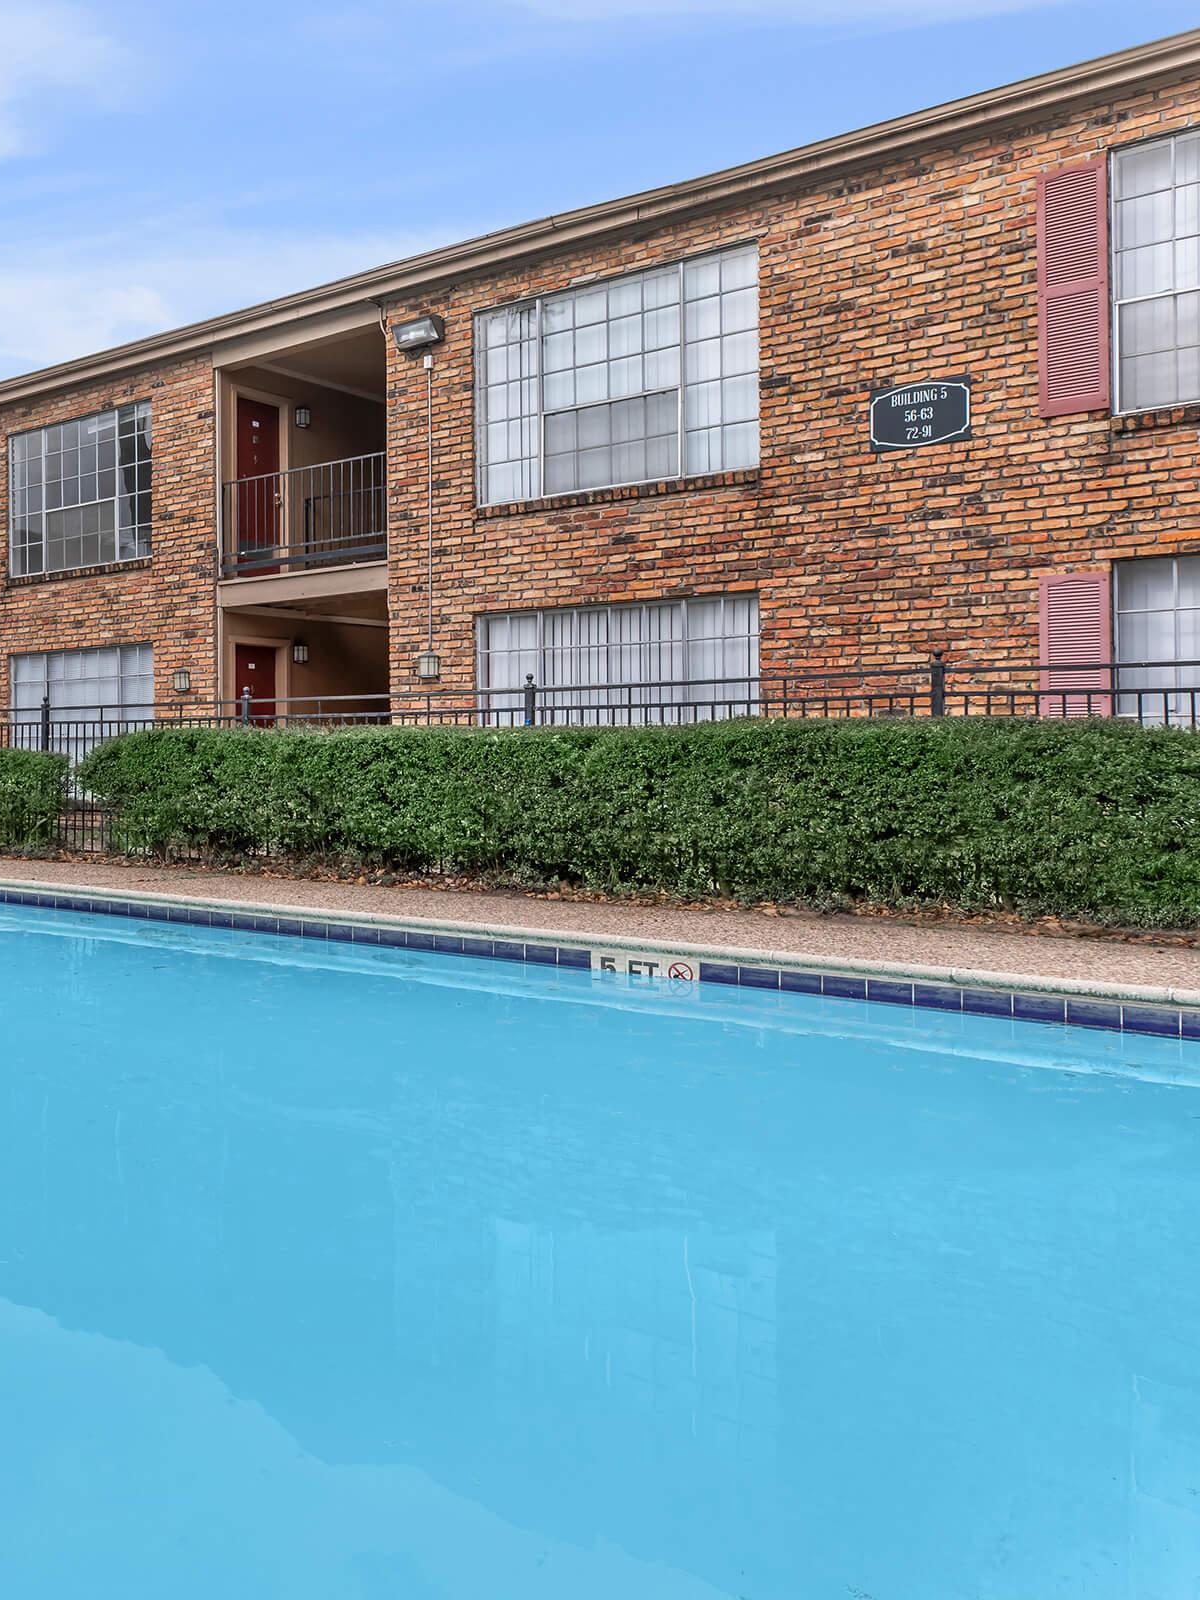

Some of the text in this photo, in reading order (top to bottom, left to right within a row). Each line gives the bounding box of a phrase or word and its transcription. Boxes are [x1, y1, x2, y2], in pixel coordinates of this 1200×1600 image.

[891, 386, 947, 407] BUILDING 5
[904, 406, 934, 422] 56-63
[905, 424, 932, 440] 72-91
[600, 956, 660, 977] 5 FT
